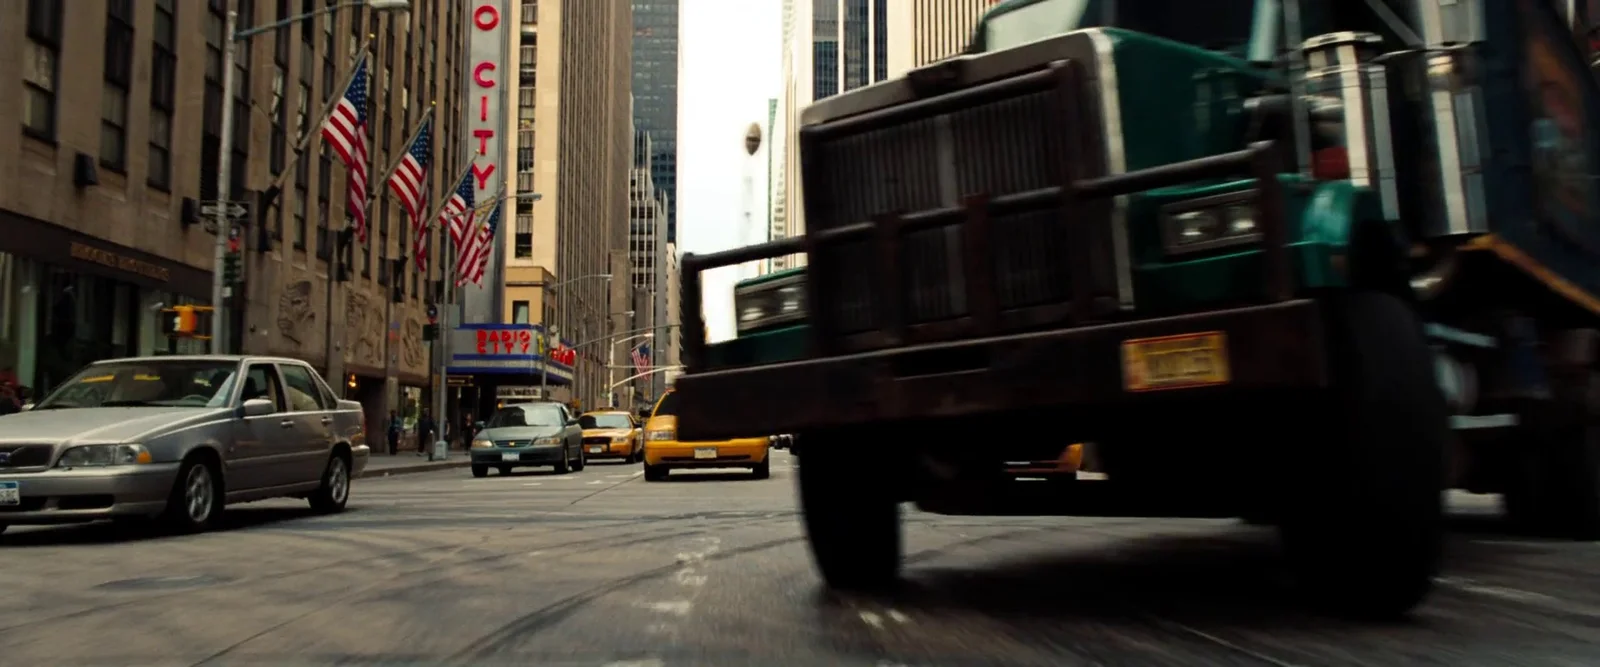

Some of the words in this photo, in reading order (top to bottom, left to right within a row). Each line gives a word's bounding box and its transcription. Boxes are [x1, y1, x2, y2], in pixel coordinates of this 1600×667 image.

[472, 62, 496, 190] CITY
[476, 329, 531, 342] RADIO
[476, 341, 530, 354] CITY
